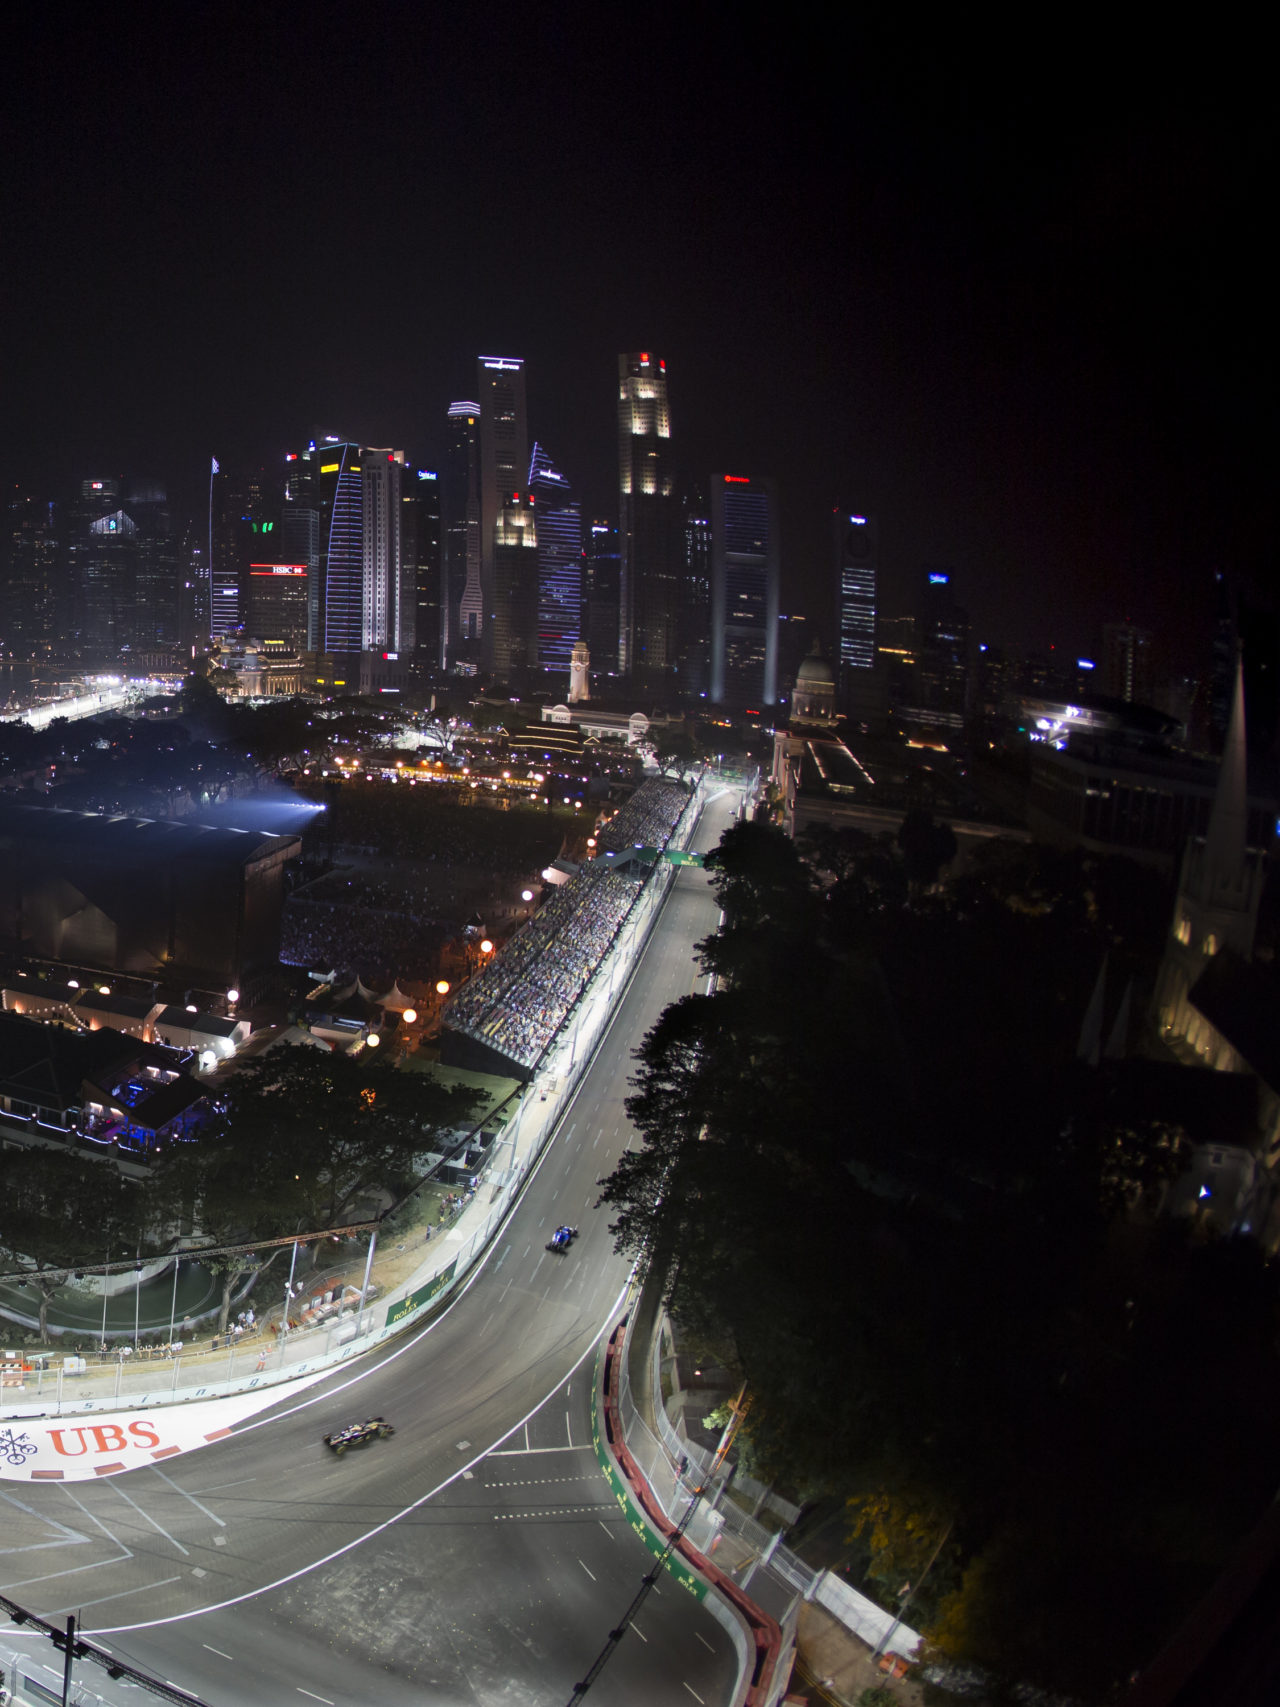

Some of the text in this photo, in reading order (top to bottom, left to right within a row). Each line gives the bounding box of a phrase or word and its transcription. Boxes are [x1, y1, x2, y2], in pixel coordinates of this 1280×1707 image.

[272, 566, 293, 574] HSBC
[393, 1302, 418, 1322] ROLEX
[45, 1420, 161, 1457] UBS
[631, 1521, 647, 1543] ROLEX
[677, 1576, 699, 1597] ROLEX
